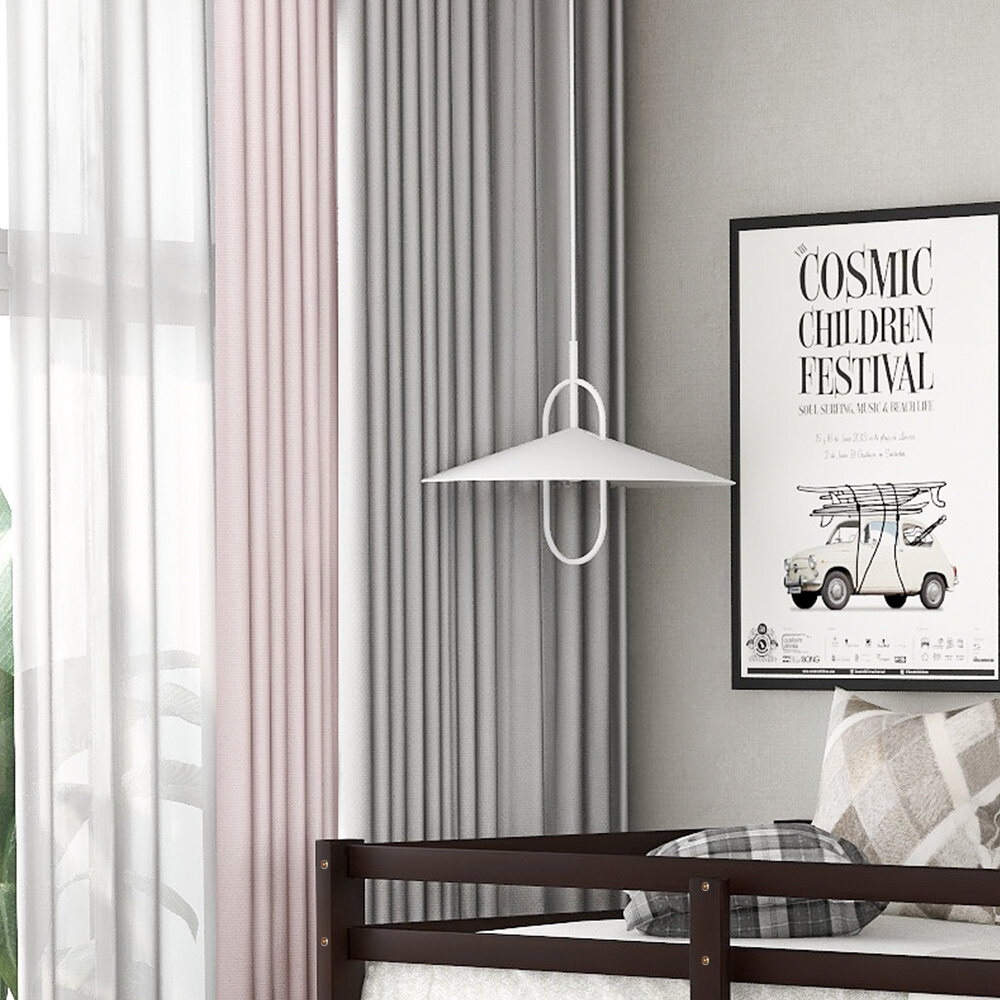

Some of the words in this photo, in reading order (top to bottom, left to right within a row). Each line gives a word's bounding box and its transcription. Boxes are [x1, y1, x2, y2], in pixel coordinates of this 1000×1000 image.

[799, 240, 934, 303] COSMIC
[799, 304, 935, 349] CHILDREN
[798, 350, 935, 398] FESTIVAL
